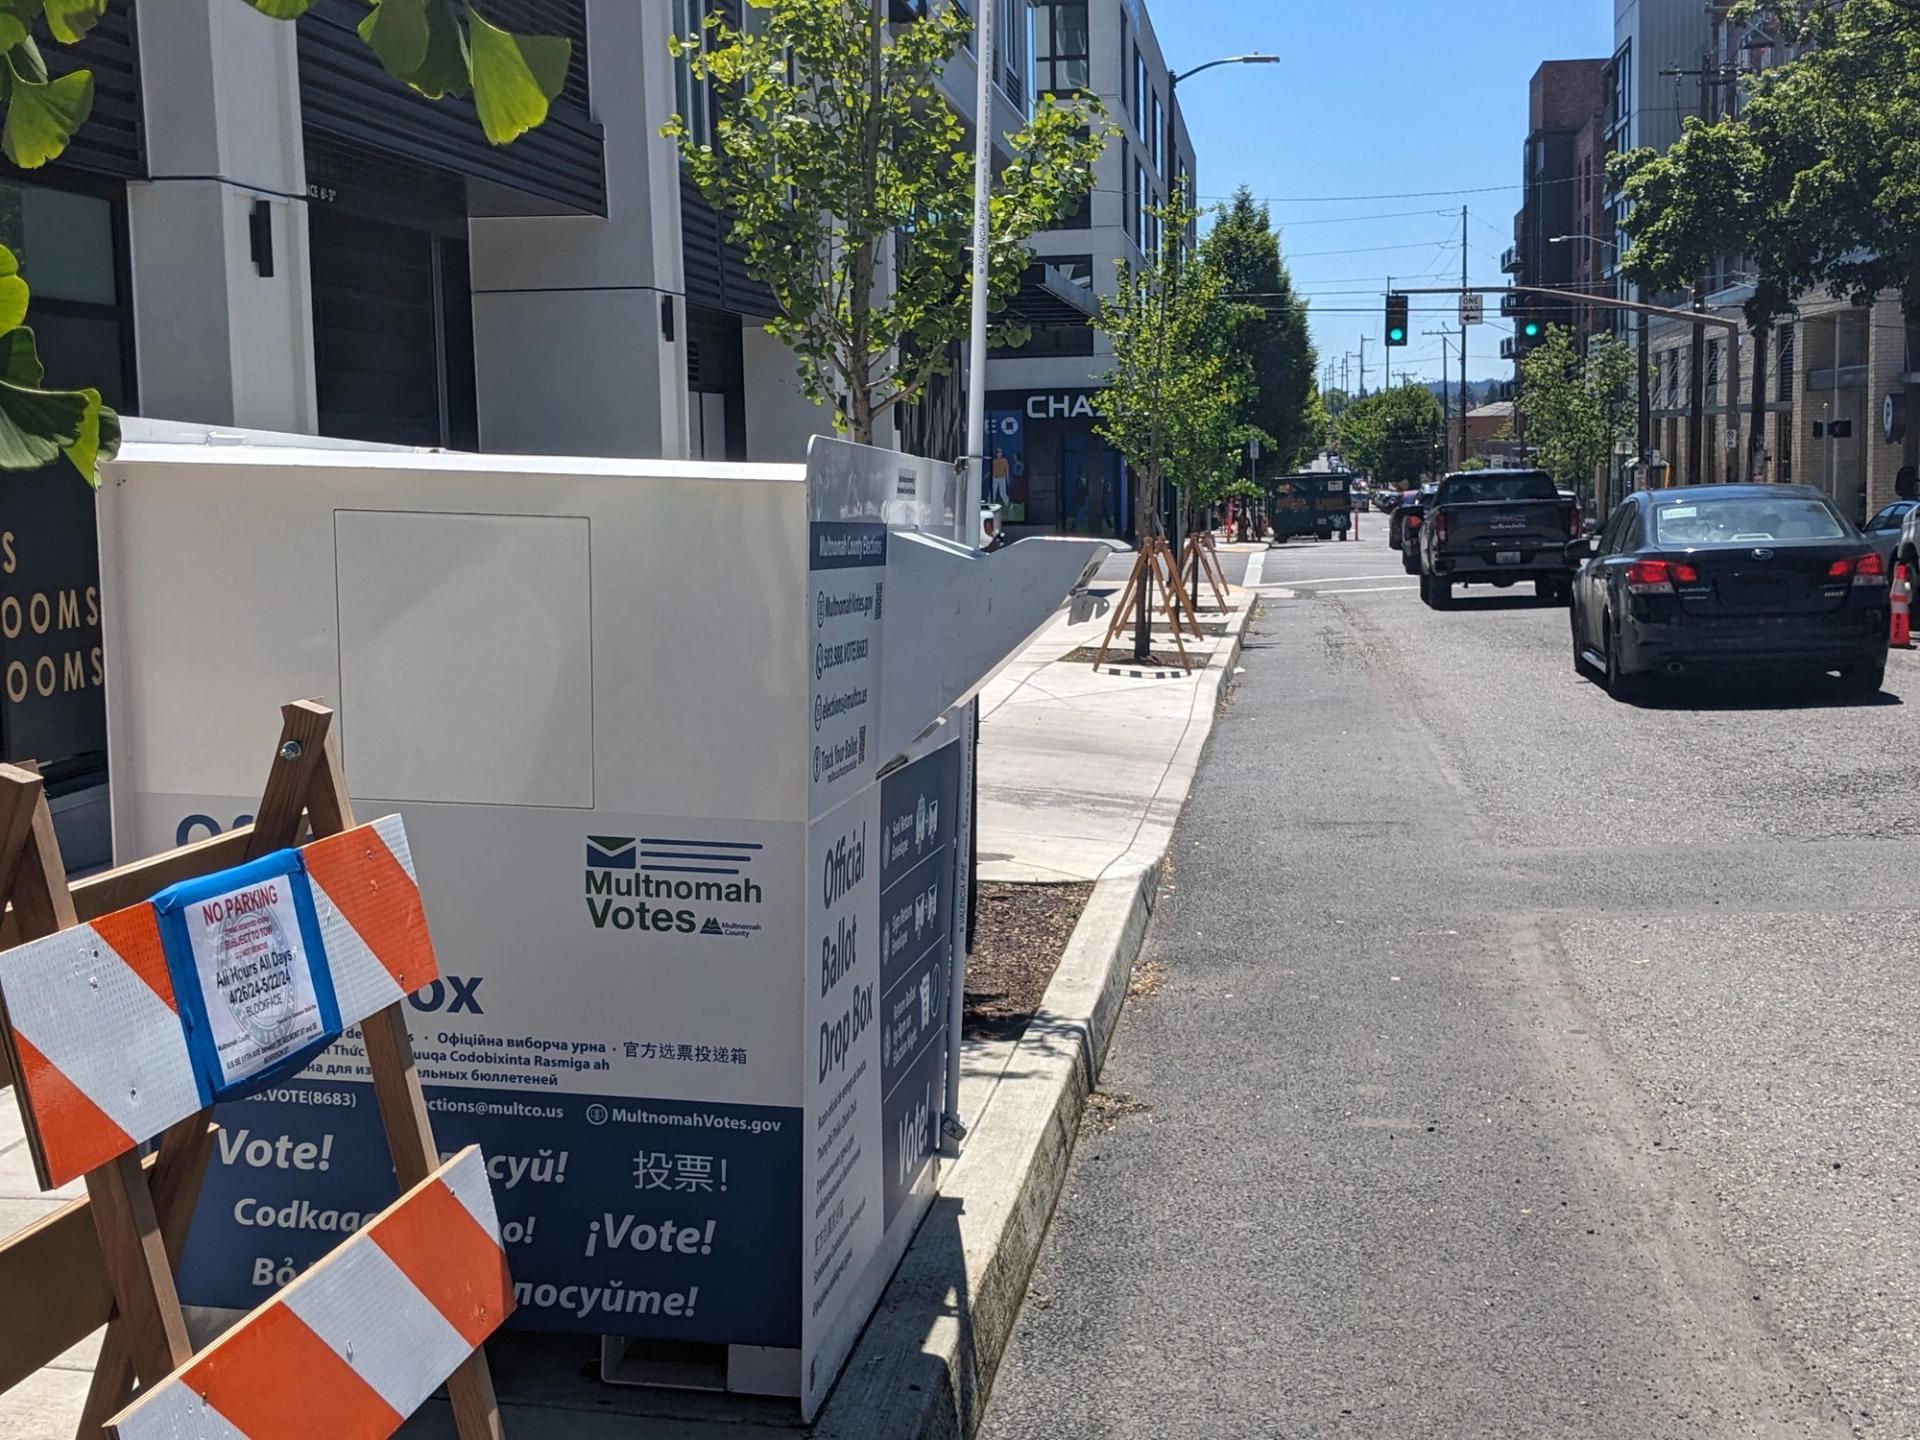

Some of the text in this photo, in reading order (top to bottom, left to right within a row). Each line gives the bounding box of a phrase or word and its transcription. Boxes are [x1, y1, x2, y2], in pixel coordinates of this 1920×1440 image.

[979, 201, 987, 219] PIPE
[1462, 297, 1480, 305] ONE
[1027, 394, 1107, 418] CHA
[823, 820, 866, 910] Official
[585, 869, 762, 903] Multnomah
[959, 863, 968, 925] VALENCIA PIPE
[202, 884, 278, 926] NO PARKING
[586, 897, 697, 934] Votes
[224, 925, 273, 950] SUBJECT TO TOW
[721, 921, 762, 931] Multnomah
[724, 929, 750, 939] County
[216, 949, 293, 989] All Hours All Days
[821, 913, 857, 999] Ballot
[229, 968, 292, 1005] 4/26/24-5/22/24
[407, 975, 484, 1015] ox
[345, 1027, 363, 1040] de
[437, 1032, 606, 1055] Офіційна виборча урна
[819, 1005, 850, 1085] Drop
[853, 981, 874, 1043] Box
[413, 1050, 610, 1072] uuqa Codobixinta Rasmiga ah
[623, 1041, 747, 1066] 官方选票投递箱
[326, 1064, 352, 1076] для
[471, 1069, 558, 1086] бюллетеней
[426, 1097, 564, 1119] ctions@multco.us
[611, 1108, 782, 1134] MultnomahVotes.gov
[217, 1127, 334, 1172] Vote!
[899, 1081, 930, 1185] Vote!
[486, 1148, 569, 1189] суй!
[584, 1212, 717, 1257] ¡Vote!
[513, 1279, 699, 1318] лосуйте!
